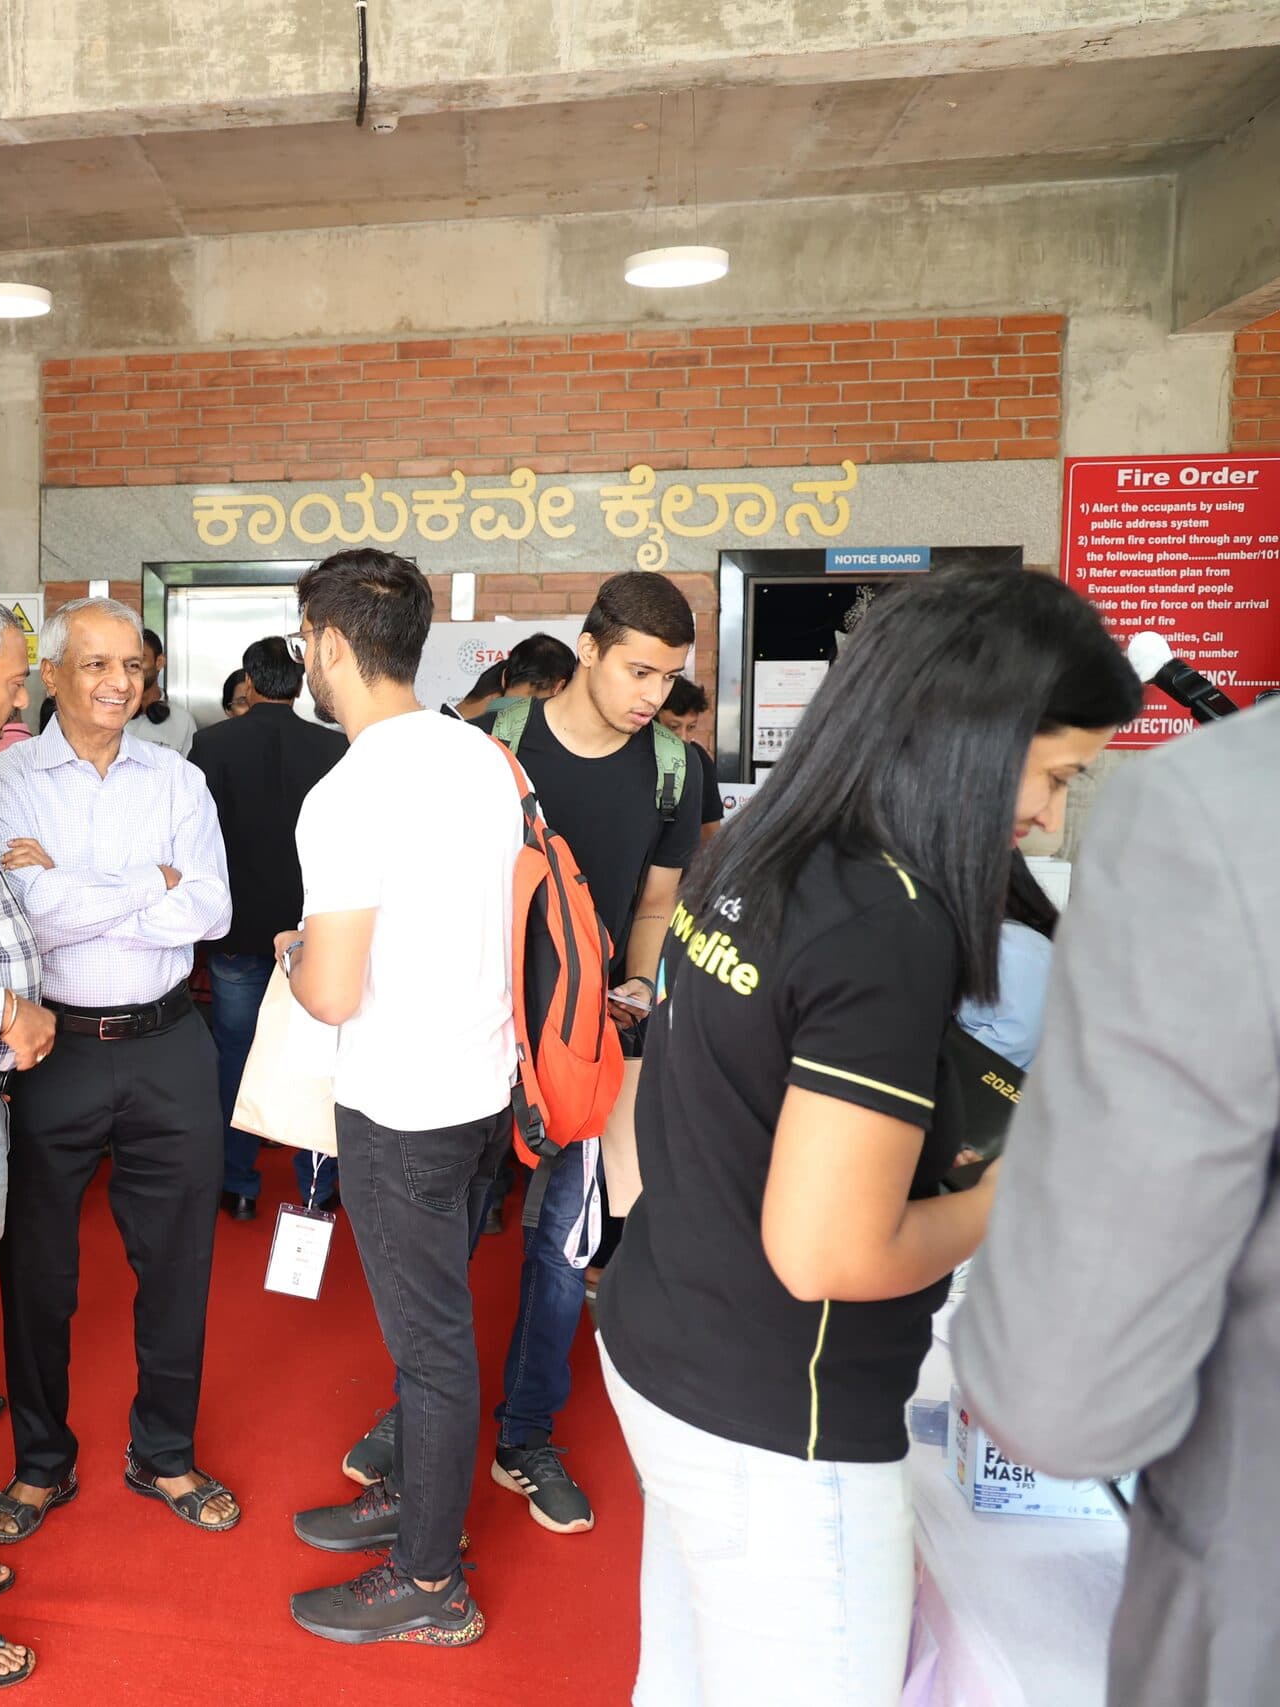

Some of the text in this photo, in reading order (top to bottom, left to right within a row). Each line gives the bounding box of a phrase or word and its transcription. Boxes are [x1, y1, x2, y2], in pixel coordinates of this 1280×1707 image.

[1117, 466, 1259, 487] Fire Order
[1079, 499, 1246, 515] 1) Alert the occupants by using
[1091, 518, 1210, 531] public address system
[1077, 535, 1088, 547] 2)
[1091, 535, 1125, 545] Inform
[1127, 535, 1146, 545] fire
[1148, 534, 1186, 545] control
[1188, 534, 1230, 545] through
[1232, 535, 1253, 545] any
[834, 554, 921, 565] NOTICE BOARD
[1086, 551, 1104, 562] the
[1106, 551, 1154, 563] following
[1076, 567, 1230, 580] 3) Refer evacuation plan from
[1088, 583, 1234, 595] Evacuation standard people
[1120, 600, 1138, 610] the
[1140, 600, 1158, 610] fire
[1160, 600, 1188, 609] force
[1190, 601, 1204, 609] on
[1206, 599, 1231, 609] their
[1234, 599, 1269, 609] arrival
[1119, 615, 1142, 626] seal
[1144, 615, 1156, 625] of
[1158, 615, 1176, 625] fire
[1202, 632, 1224, 642] Call
[1198, 648, 1239, 658] number
[981, 1071, 1023, 1105] 2022
[983, 1464, 1035, 1482] MASK
